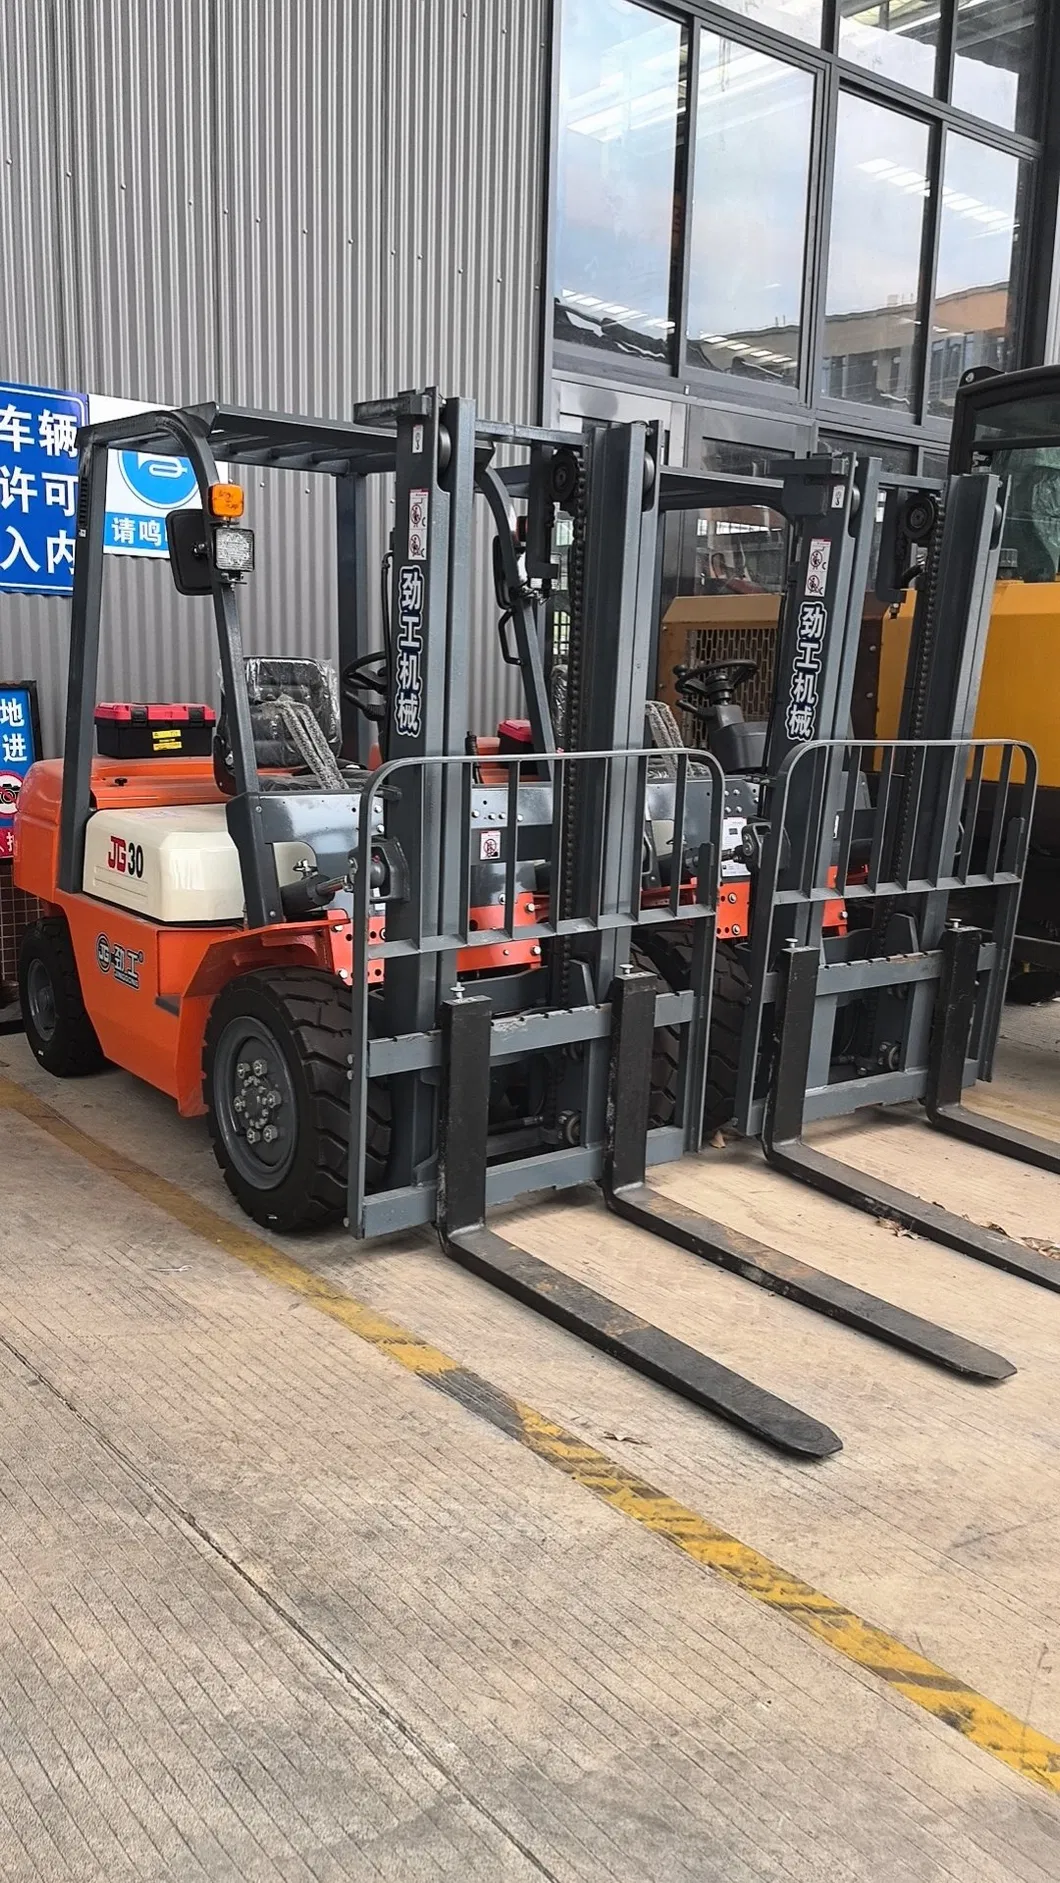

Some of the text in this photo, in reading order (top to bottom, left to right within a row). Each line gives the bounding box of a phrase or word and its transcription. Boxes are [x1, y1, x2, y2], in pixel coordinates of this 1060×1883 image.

[0, 404, 78, 458] 车辆
[0, 465, 79, 517] 许可
[0, 525, 76, 575] 入内
[111, 517, 168, 547] 请鸣
[396, 569, 423, 733] 劲工机械
[787, 604, 825, 738] 劲工机械
[3, 733, 28, 763] 进
